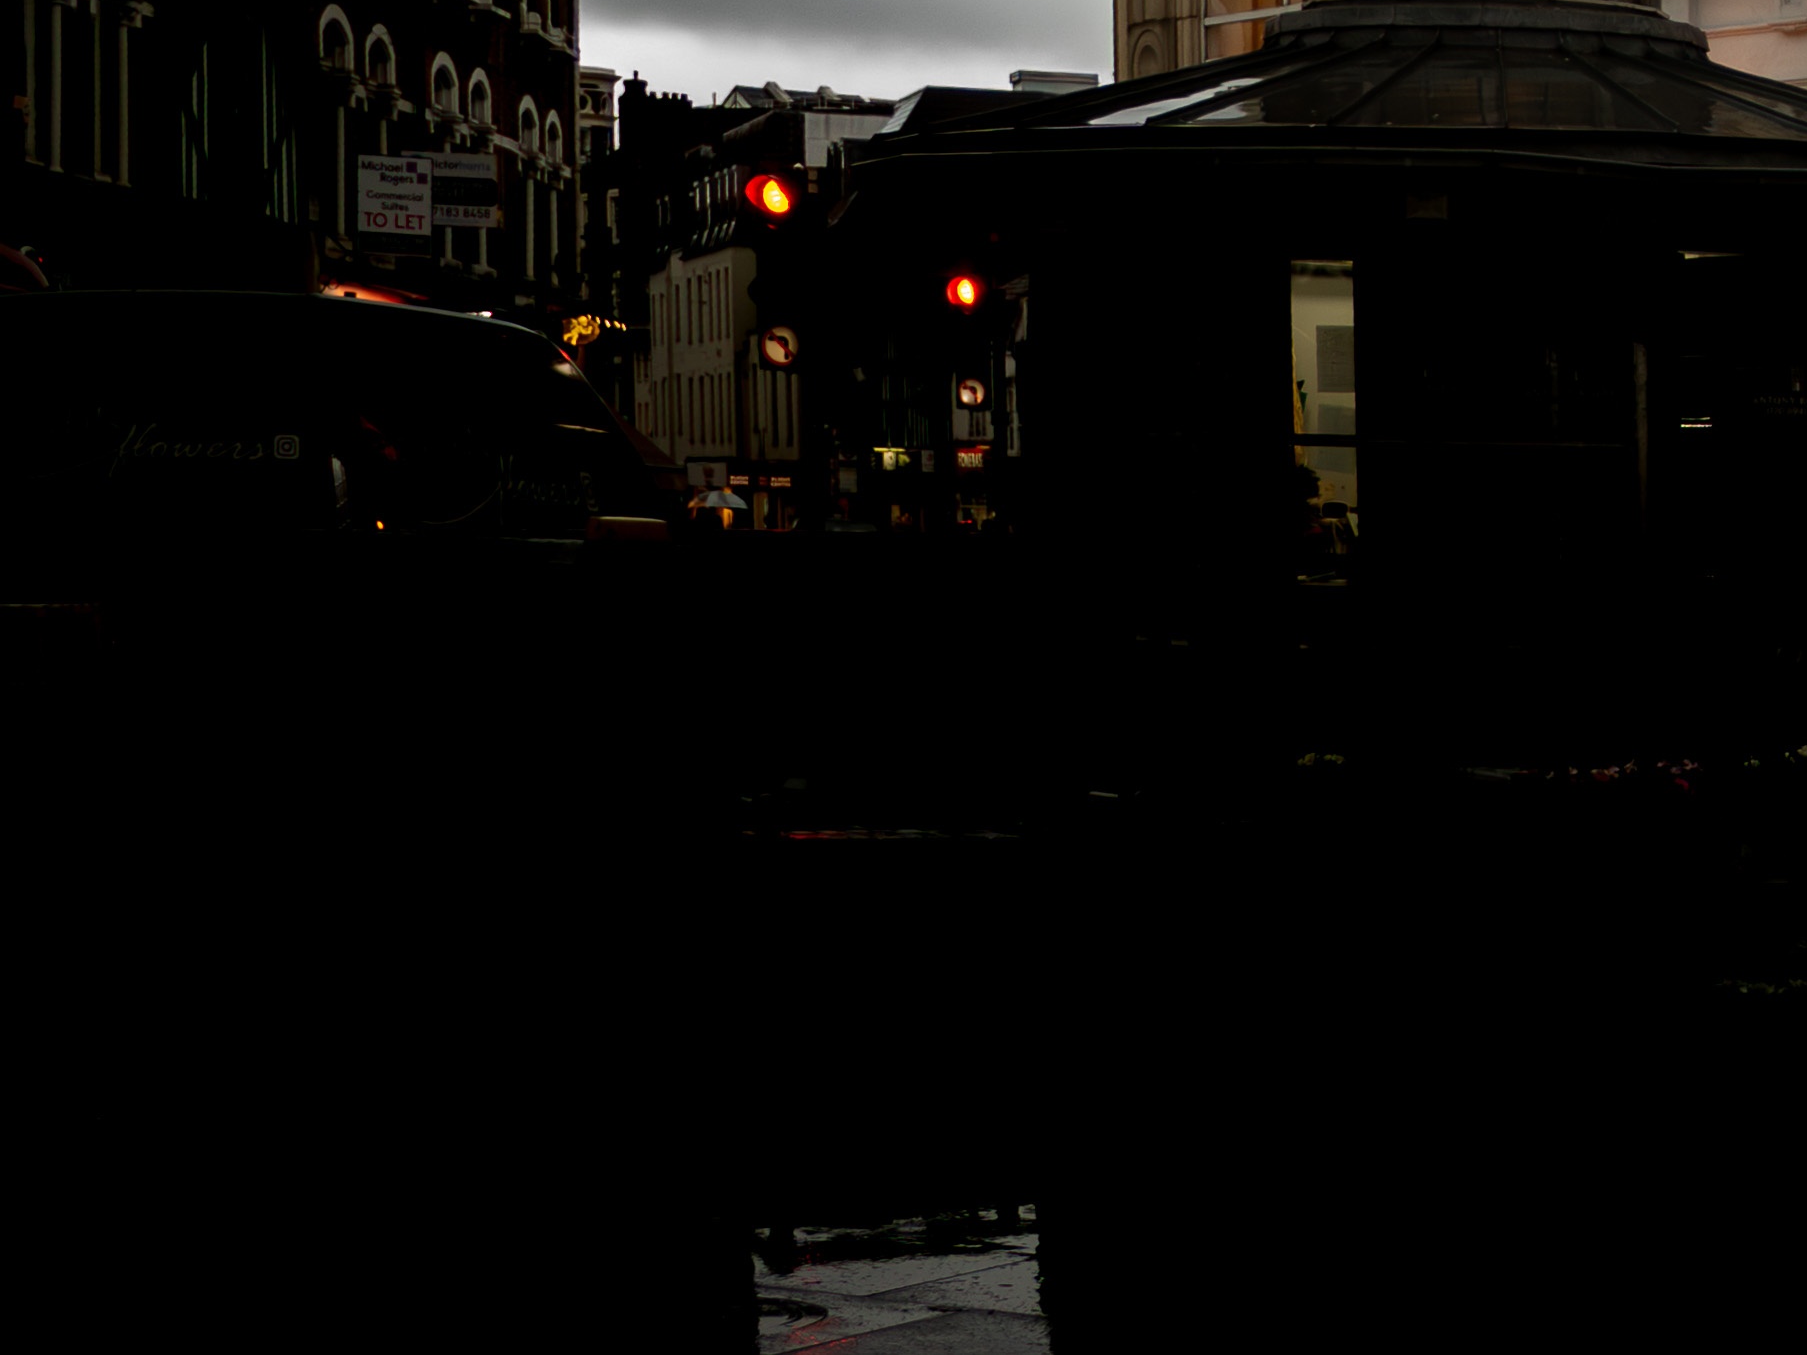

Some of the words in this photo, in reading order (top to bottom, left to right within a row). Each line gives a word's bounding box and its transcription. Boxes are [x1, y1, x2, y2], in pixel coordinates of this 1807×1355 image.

[360, 159, 405, 173] Michael
[380, 172, 414, 187] Rogers
[363, 211, 388, 229] TO
[394, 213, 426, 231] LET
